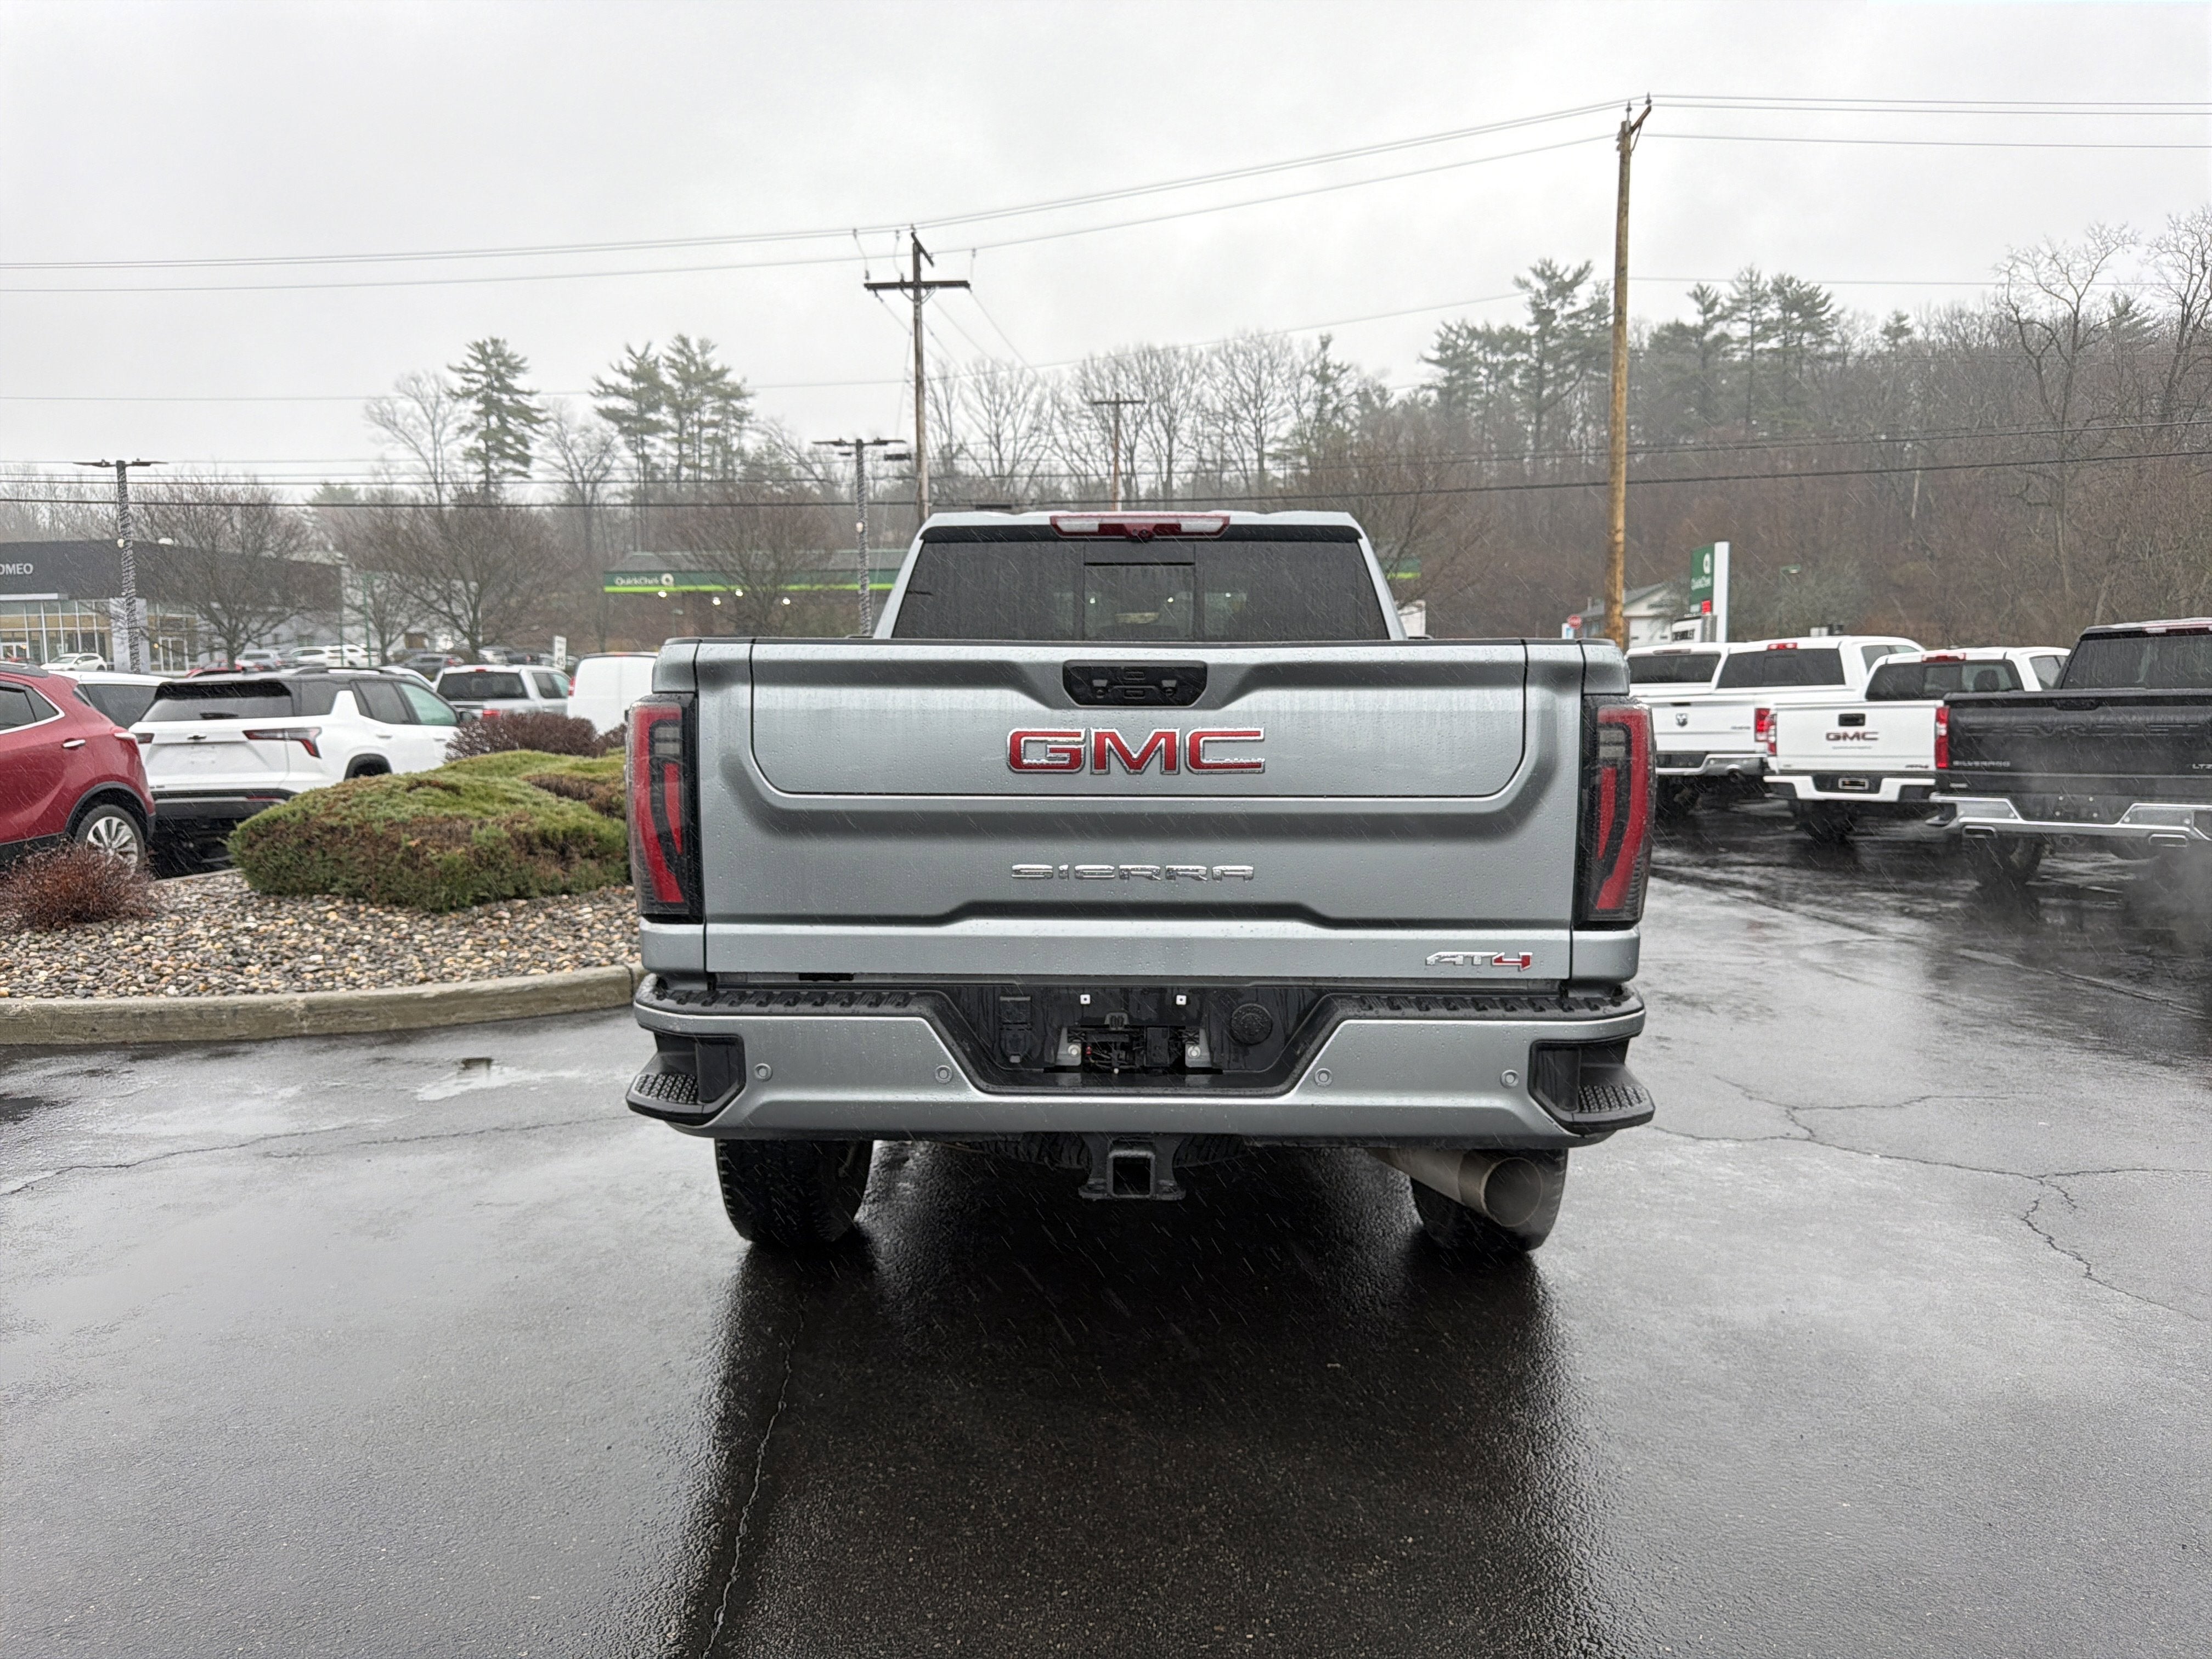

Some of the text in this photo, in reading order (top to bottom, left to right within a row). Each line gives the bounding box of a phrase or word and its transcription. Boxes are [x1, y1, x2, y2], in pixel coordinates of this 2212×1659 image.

[1826, 731, 1878, 741] GMC
[1007, 727, 1265, 774] GMC
[1012, 864, 1254, 882] SIERRA
[1425, 951, 1533, 972] AT4
